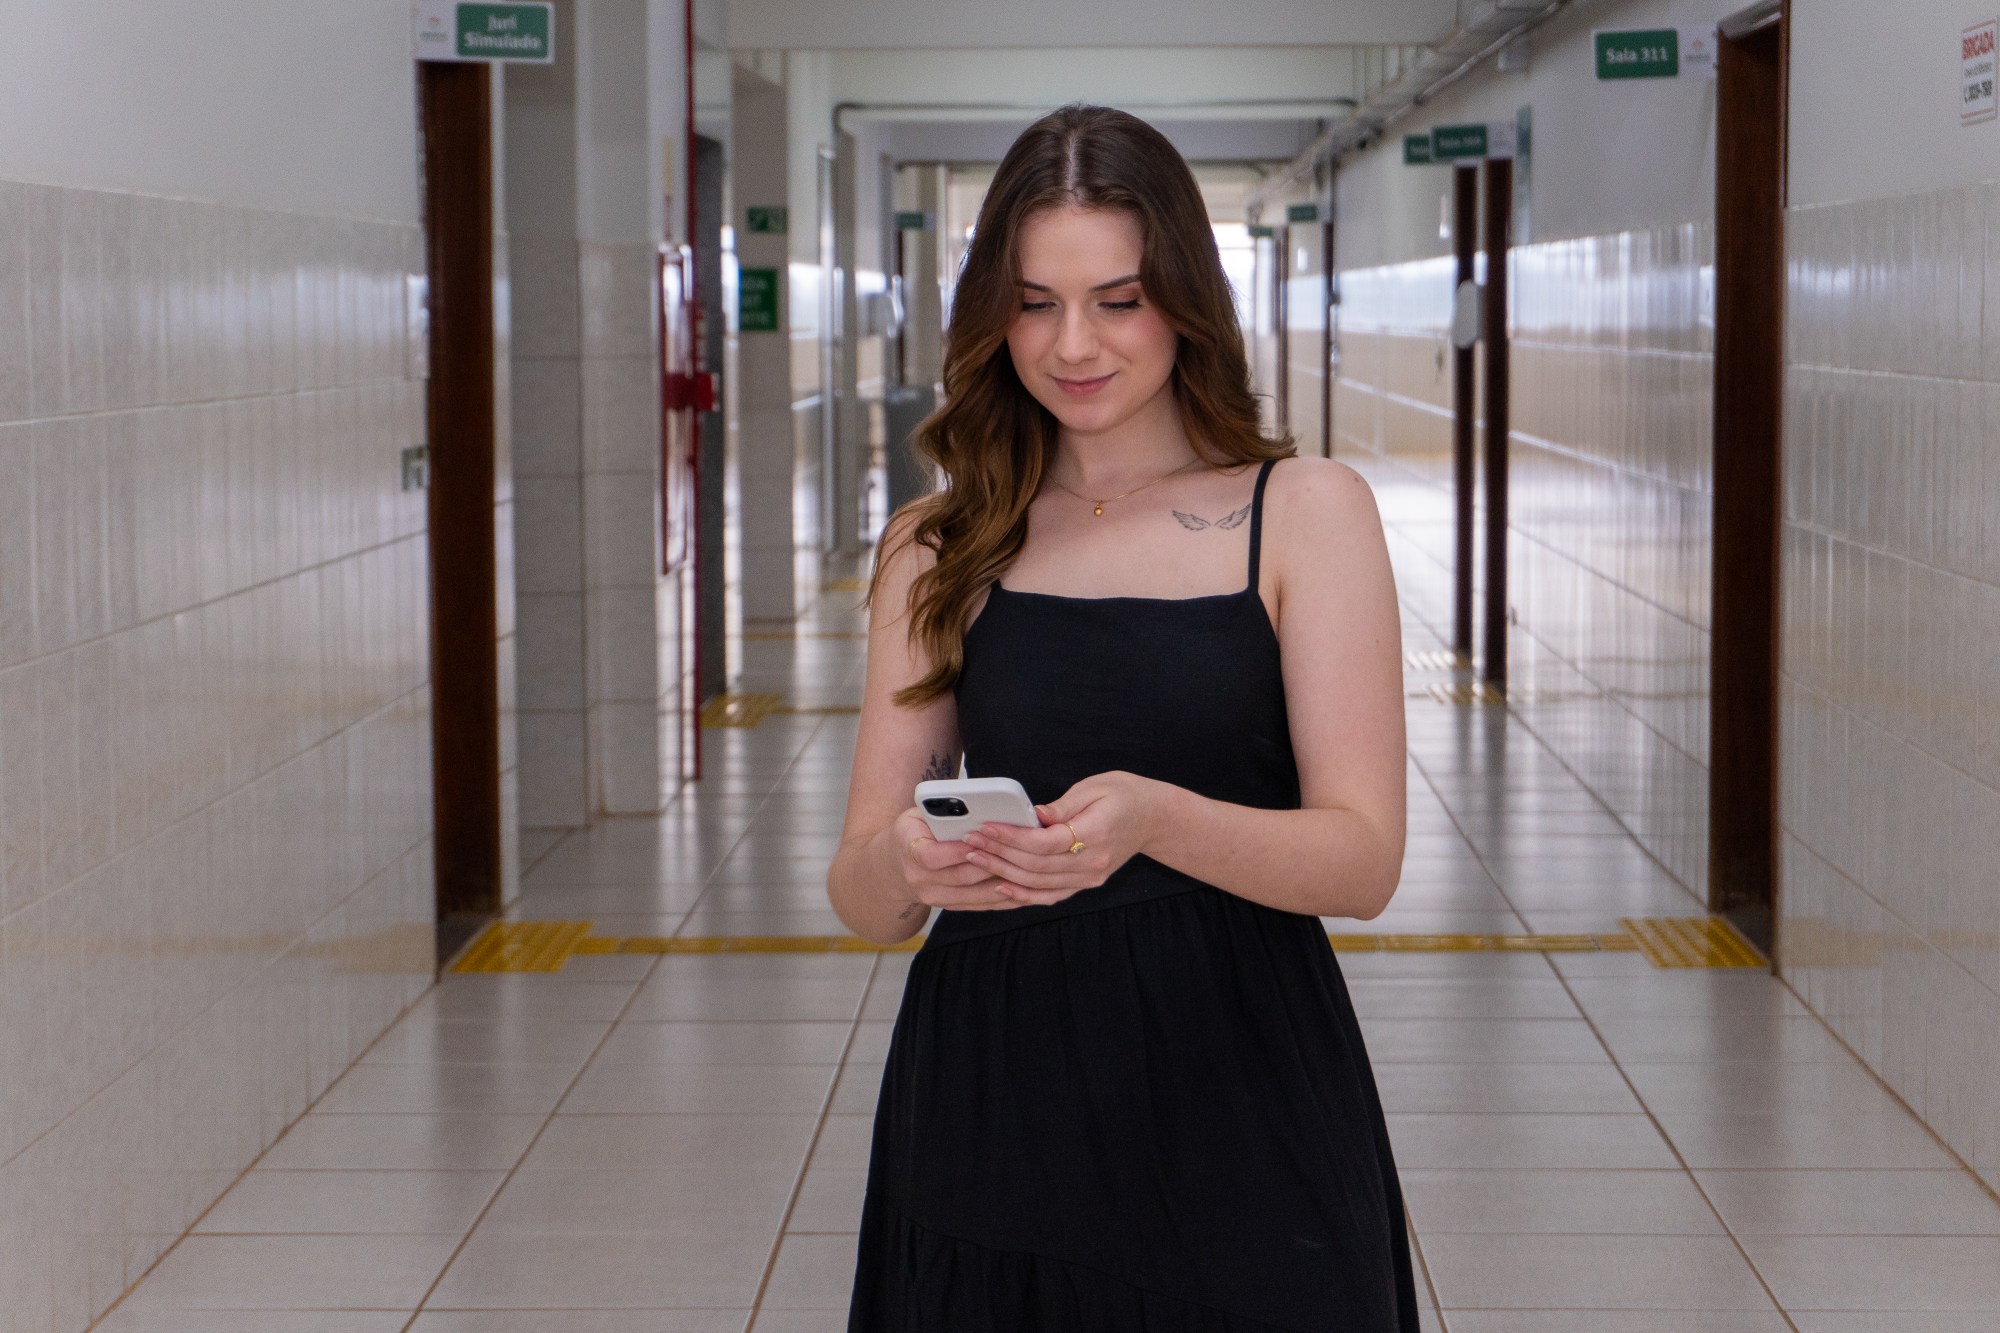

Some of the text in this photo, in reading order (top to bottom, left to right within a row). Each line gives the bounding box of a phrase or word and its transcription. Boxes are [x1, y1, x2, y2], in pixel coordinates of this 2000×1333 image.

[464, 32, 542, 50] Simulado
[1963, 31, 1994, 59] BRIGADA
[1607, 48, 1638, 63] Sala
[1642, 47, 1668, 63] 311
